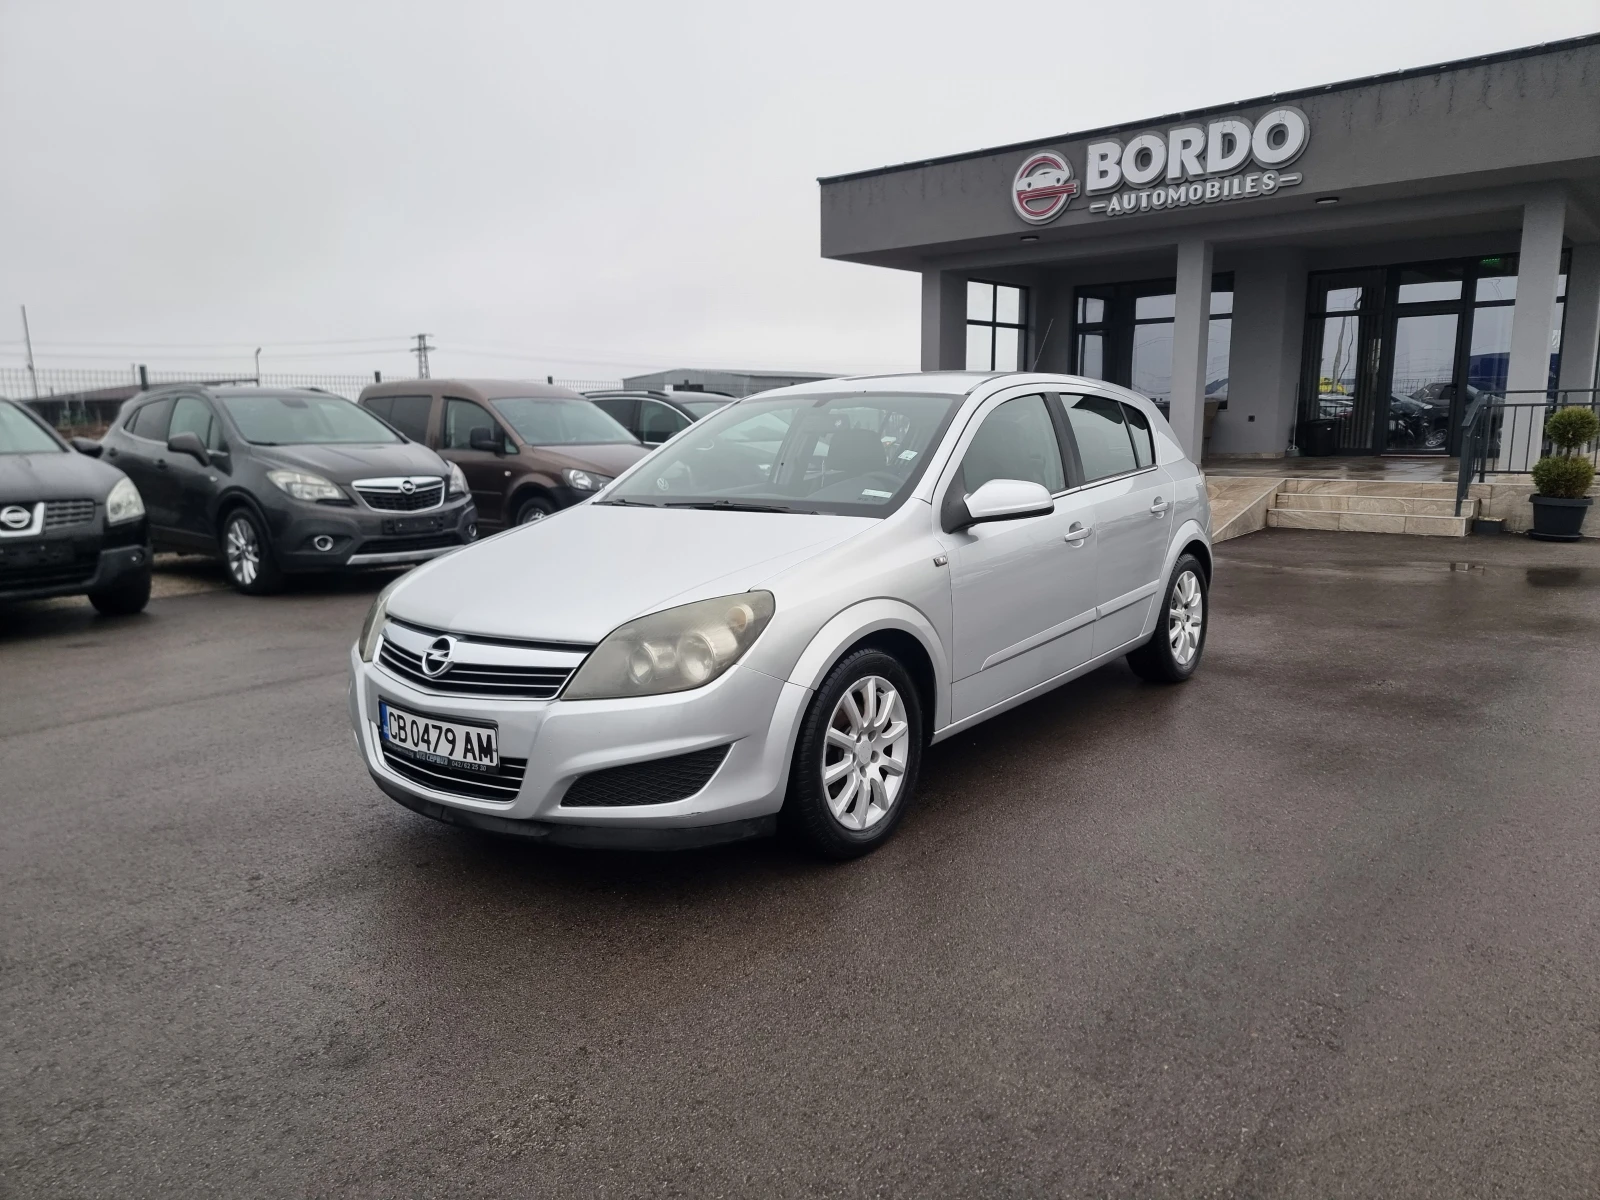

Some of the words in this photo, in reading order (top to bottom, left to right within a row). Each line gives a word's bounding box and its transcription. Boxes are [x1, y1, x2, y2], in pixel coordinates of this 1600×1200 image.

[1086, 109, 1305, 191] BORDO
[1108, 173, 1275, 213] AUTOMOBILES
[463, 731, 494, 764] AM
